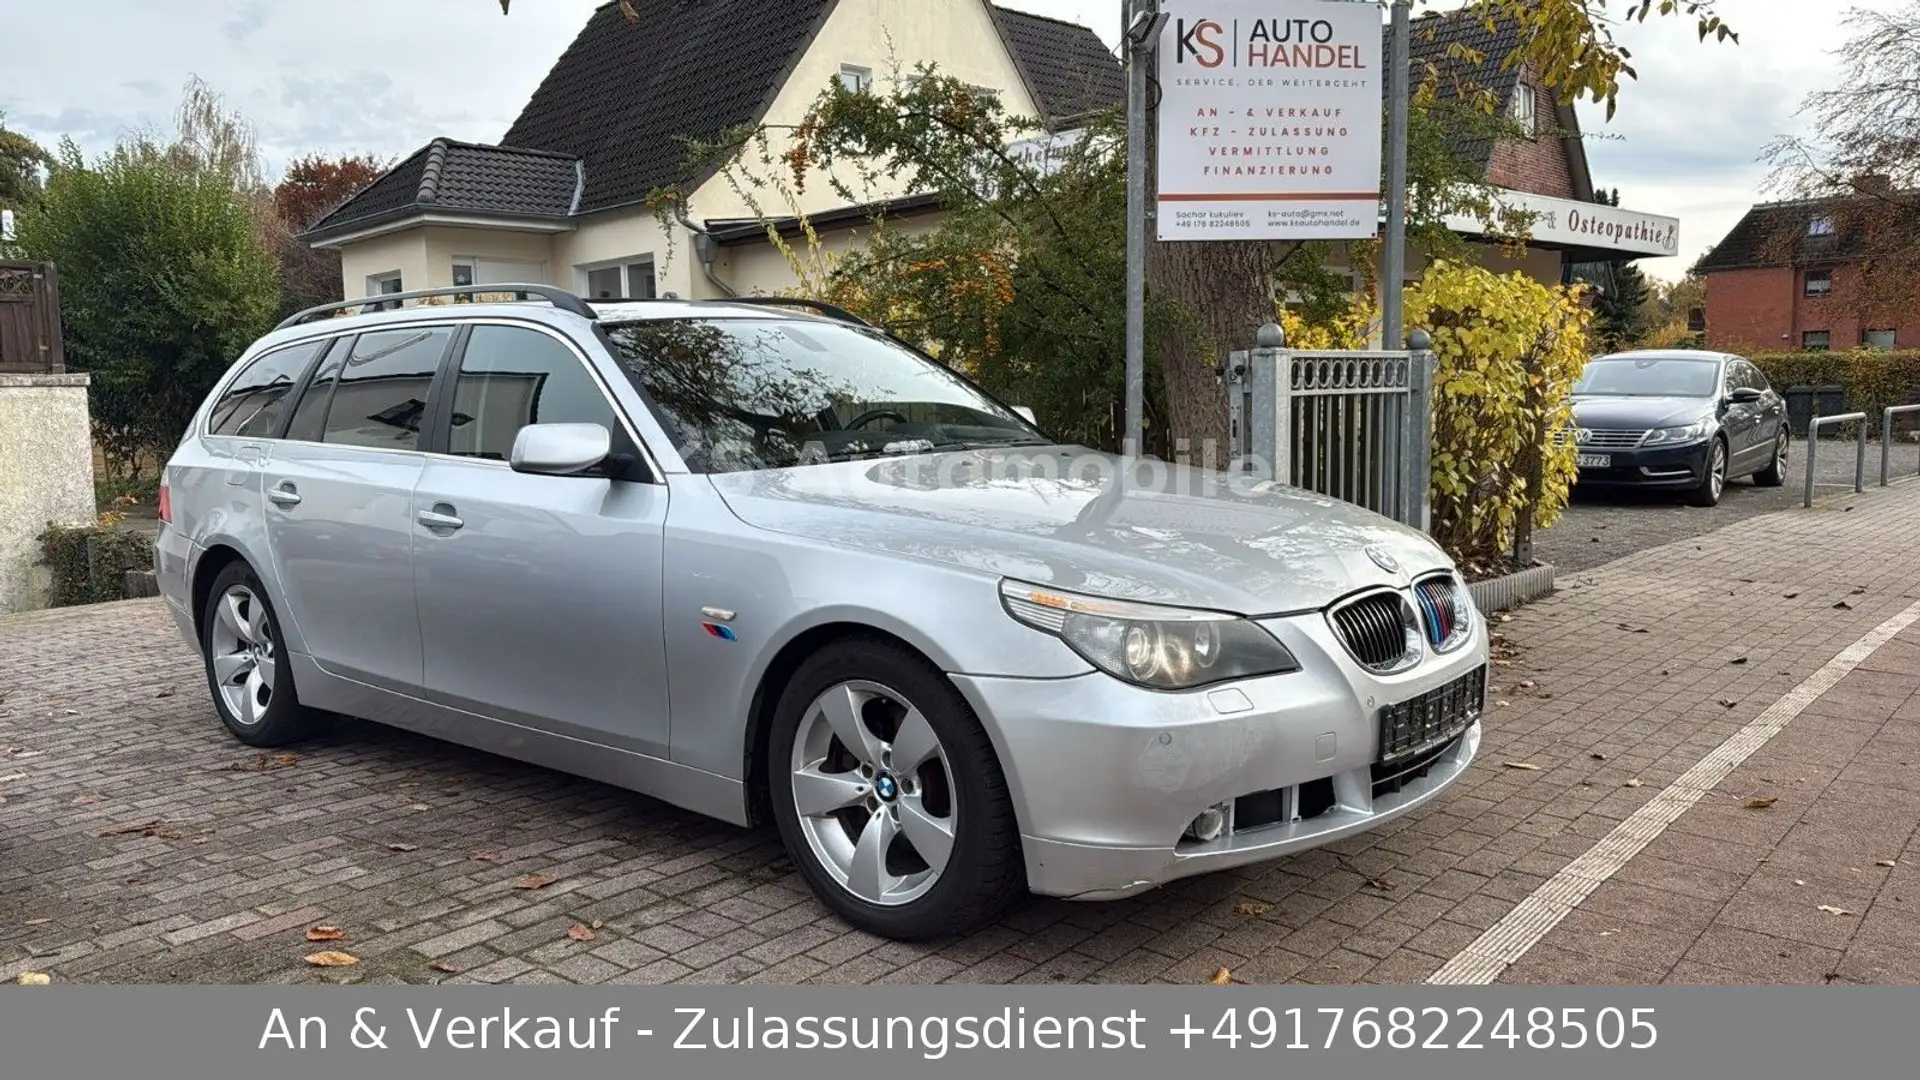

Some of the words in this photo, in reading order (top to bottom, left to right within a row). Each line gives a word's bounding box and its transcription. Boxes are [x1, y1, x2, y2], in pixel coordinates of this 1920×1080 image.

[1249, 19, 1333, 43] AUTO
[1177, 18, 1224, 68] KS
[1248, 43, 1366, 69] HANDEL
[1248, 78, 1274, 87] DER
[1281, 79, 1367, 88] WEITERGEHT
[1197, 107, 1218, 117] AN
[1246, 107, 1254, 117] &
[1265, 107, 1342, 118] VERKAUF
[1190, 126, 1220, 137] KFZ
[1248, 127, 1348, 137] ZULASSUNG
[1208, 146, 1329, 156] VERMITTLUNG
[1203, 165, 1333, 176] FINANZIERUNG
[1568, 209, 1663, 244] Osteopathie
